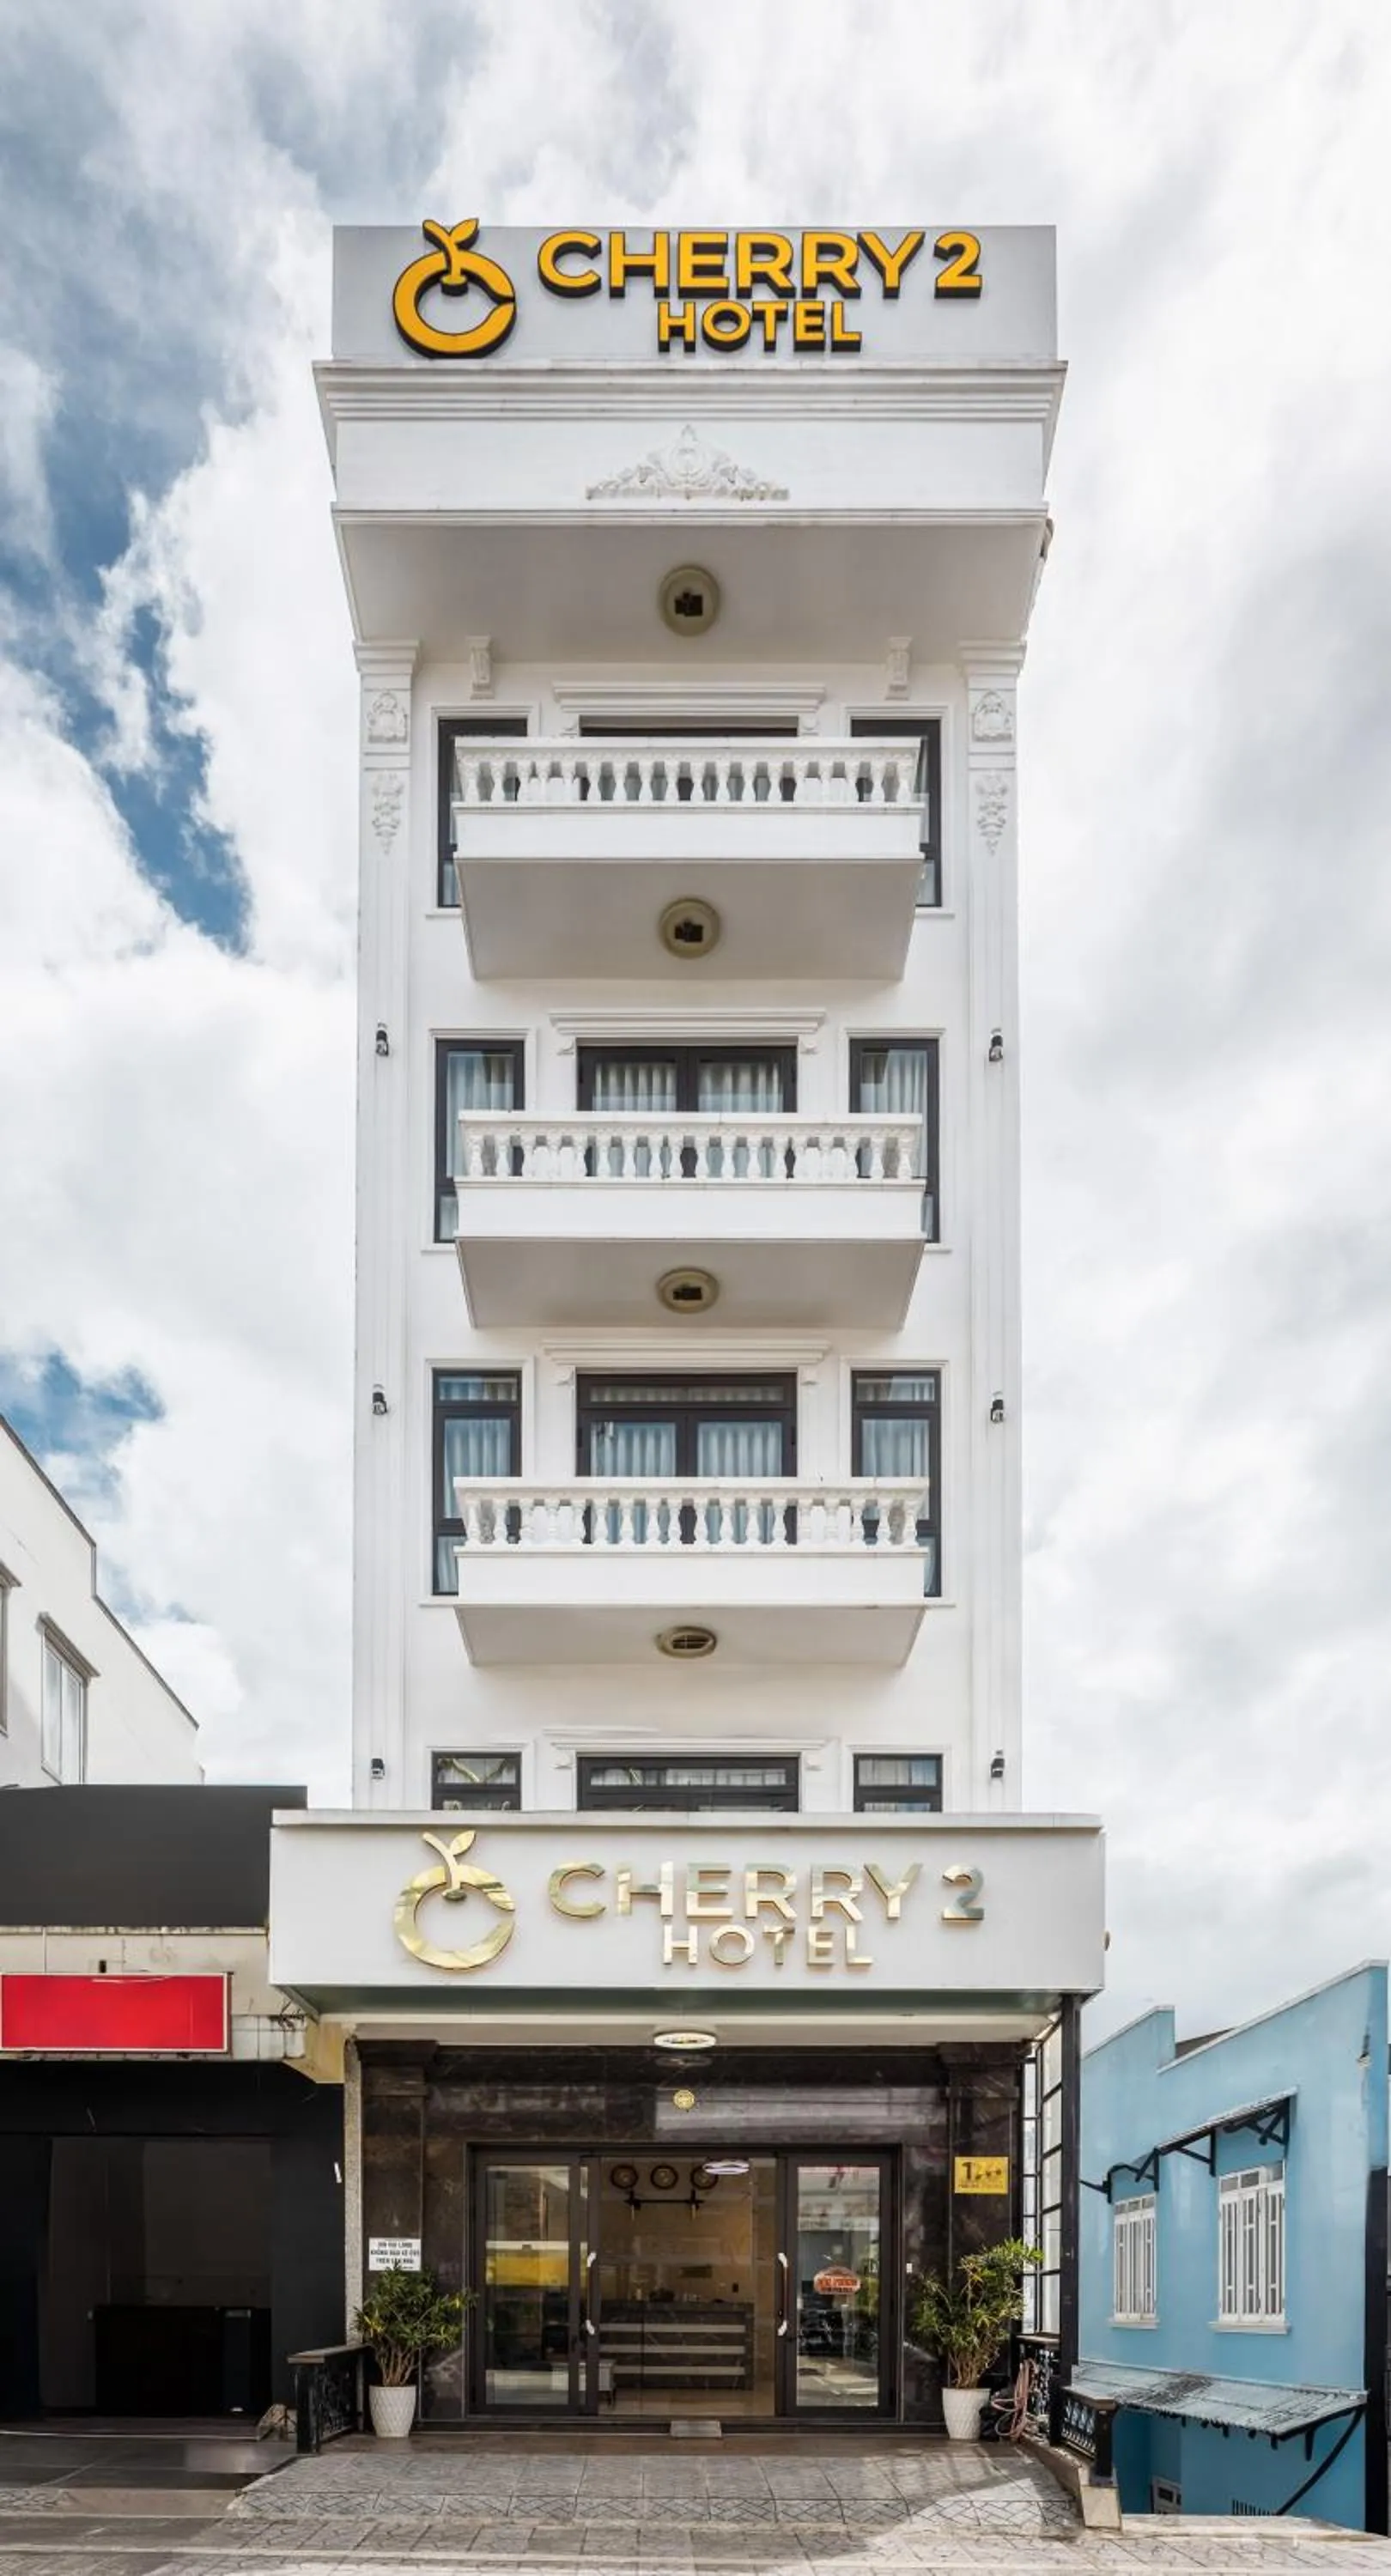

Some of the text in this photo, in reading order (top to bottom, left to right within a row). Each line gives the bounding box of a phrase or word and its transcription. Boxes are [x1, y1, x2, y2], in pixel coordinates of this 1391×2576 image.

[538, 231, 983, 298] CHERRY 2
[657, 300, 862, 352] HOTEL
[548, 1862, 986, 1921] CHERRY 2
[665, 1925, 872, 1965] HOTEL
